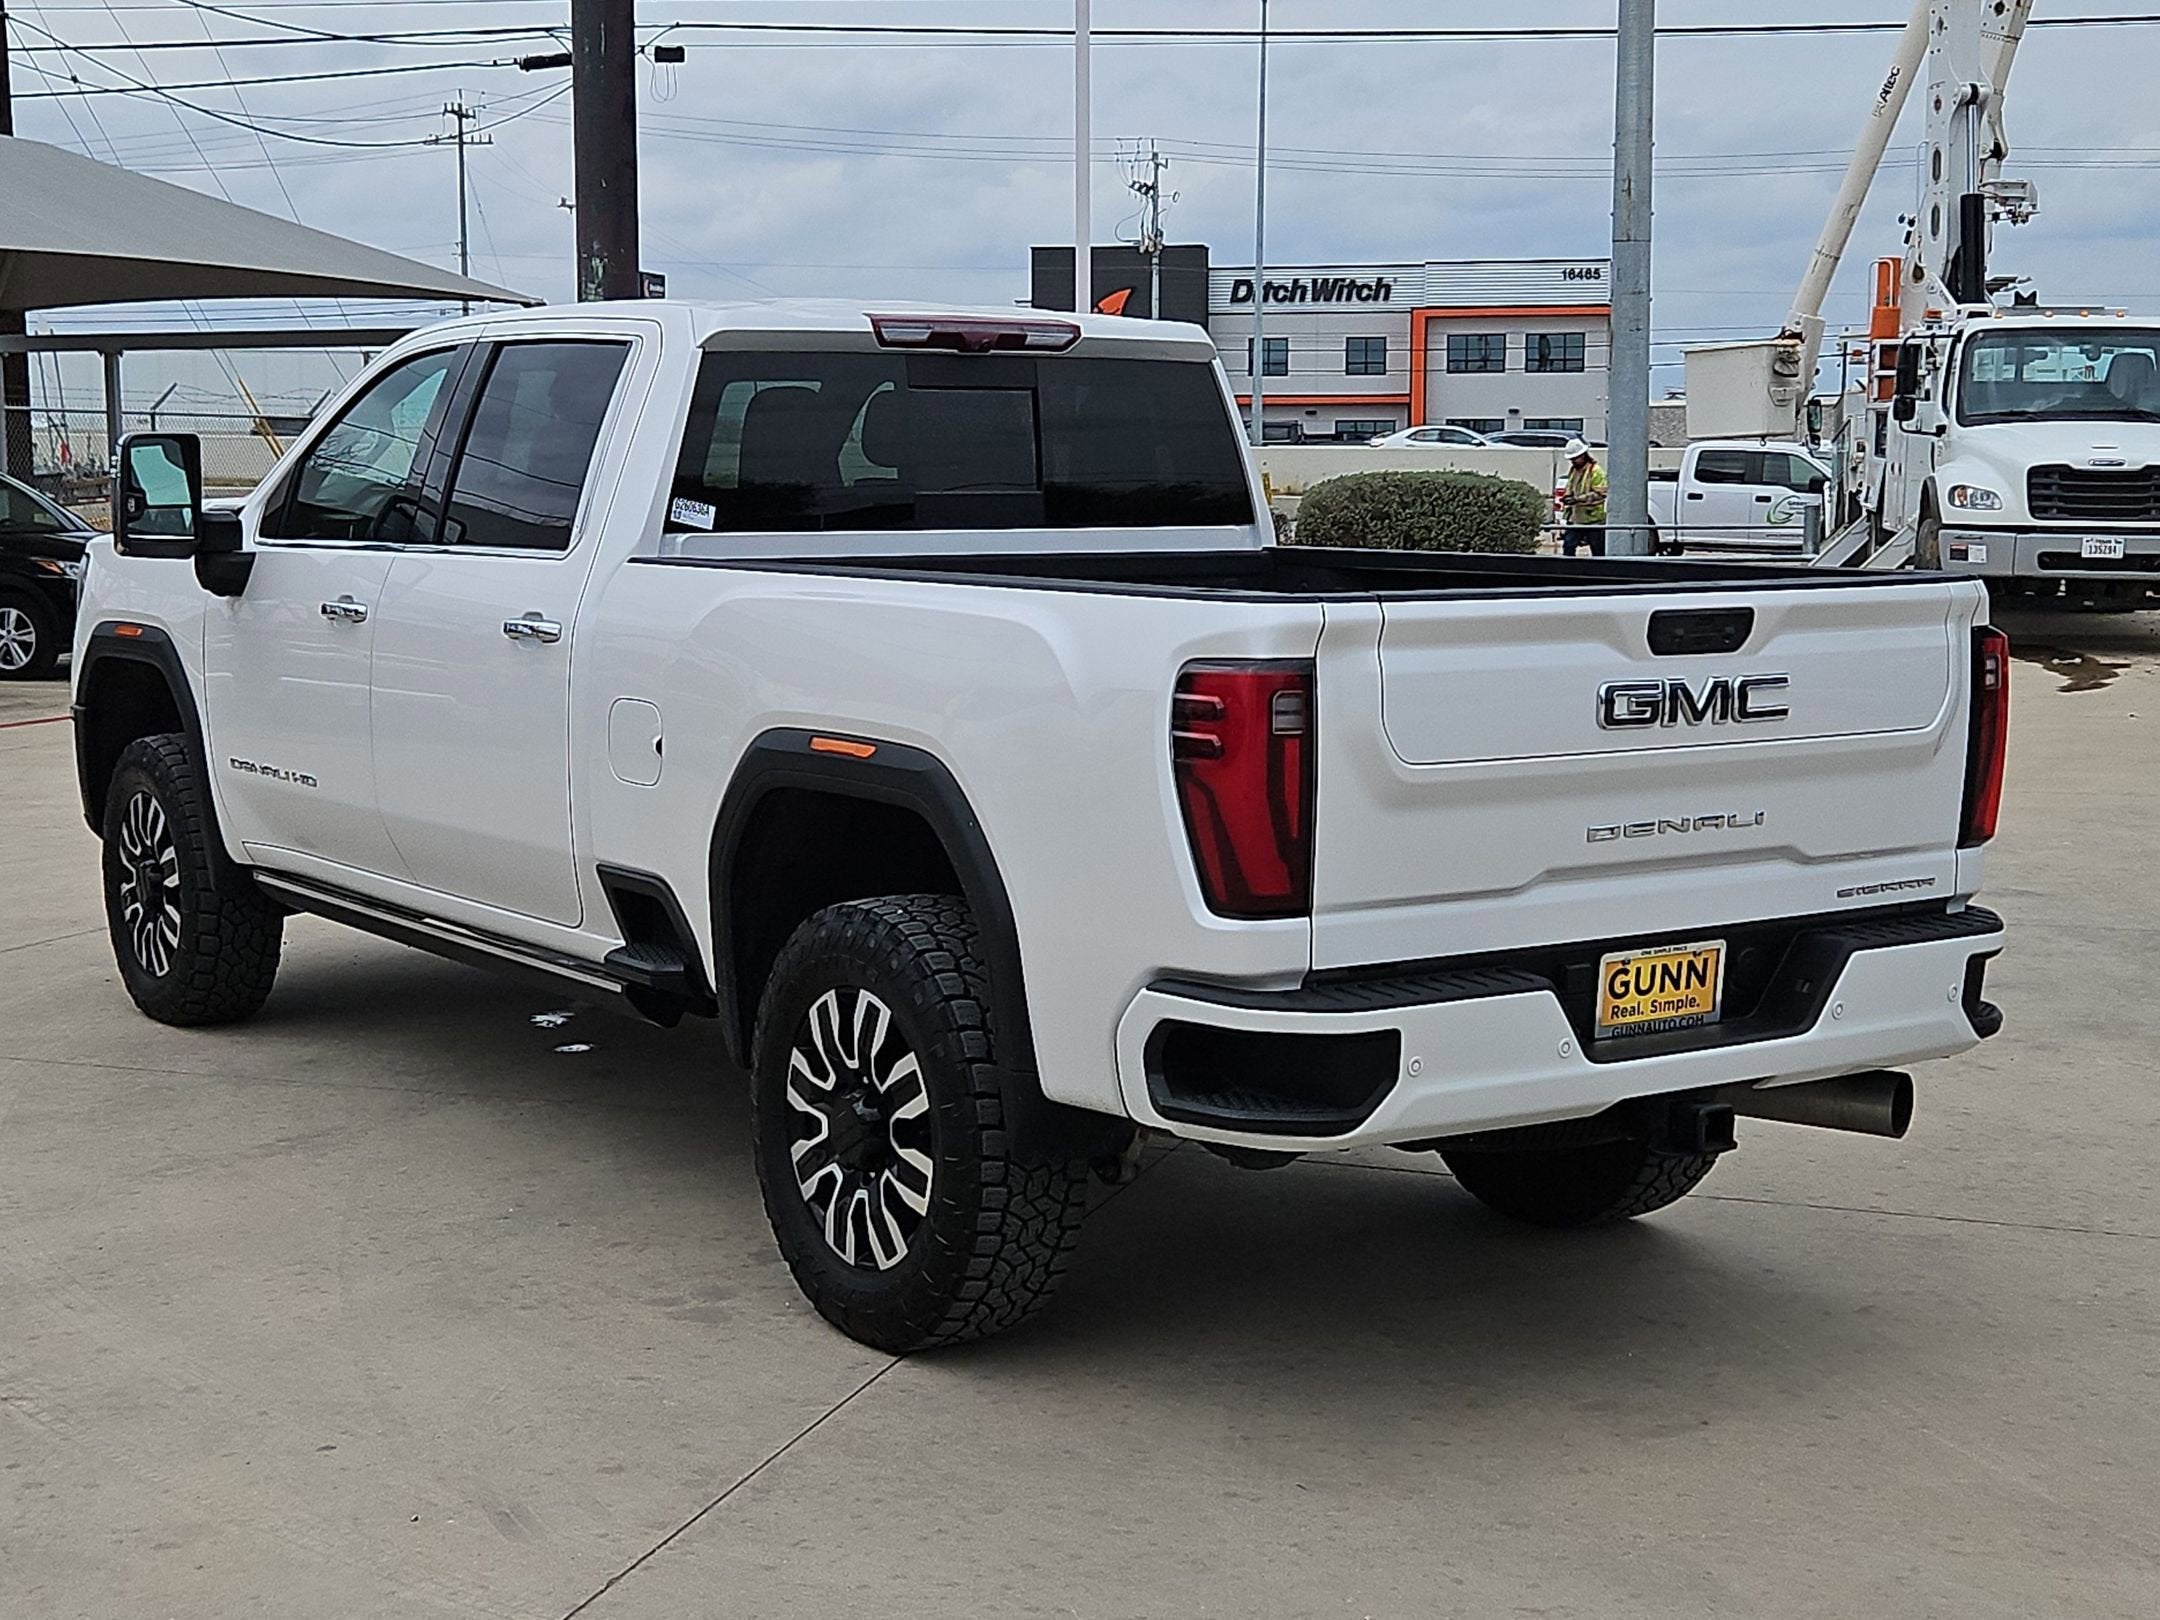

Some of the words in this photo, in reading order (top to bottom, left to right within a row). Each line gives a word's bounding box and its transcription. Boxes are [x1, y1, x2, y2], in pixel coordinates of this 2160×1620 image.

[1880, 66, 1900, 103] Altec
[1230, 278, 1307, 303] Dtch
[1311, 277, 1392, 303] Witch
[1596, 672, 1789, 730] GMC
[229, 757, 290, 781] DENALI
[291, 771, 318, 788] HD
[1586, 811, 1765, 843] DENALI
[1836, 877, 1936, 898] SIERRA
[1608, 957, 1710, 1000] GUNN
[1610, 1001, 1645, 1020] Real.
[1649, 994, 1701, 1014] Simple.
[1611, 1014, 1705, 1038] GUNNAUTO.COM
